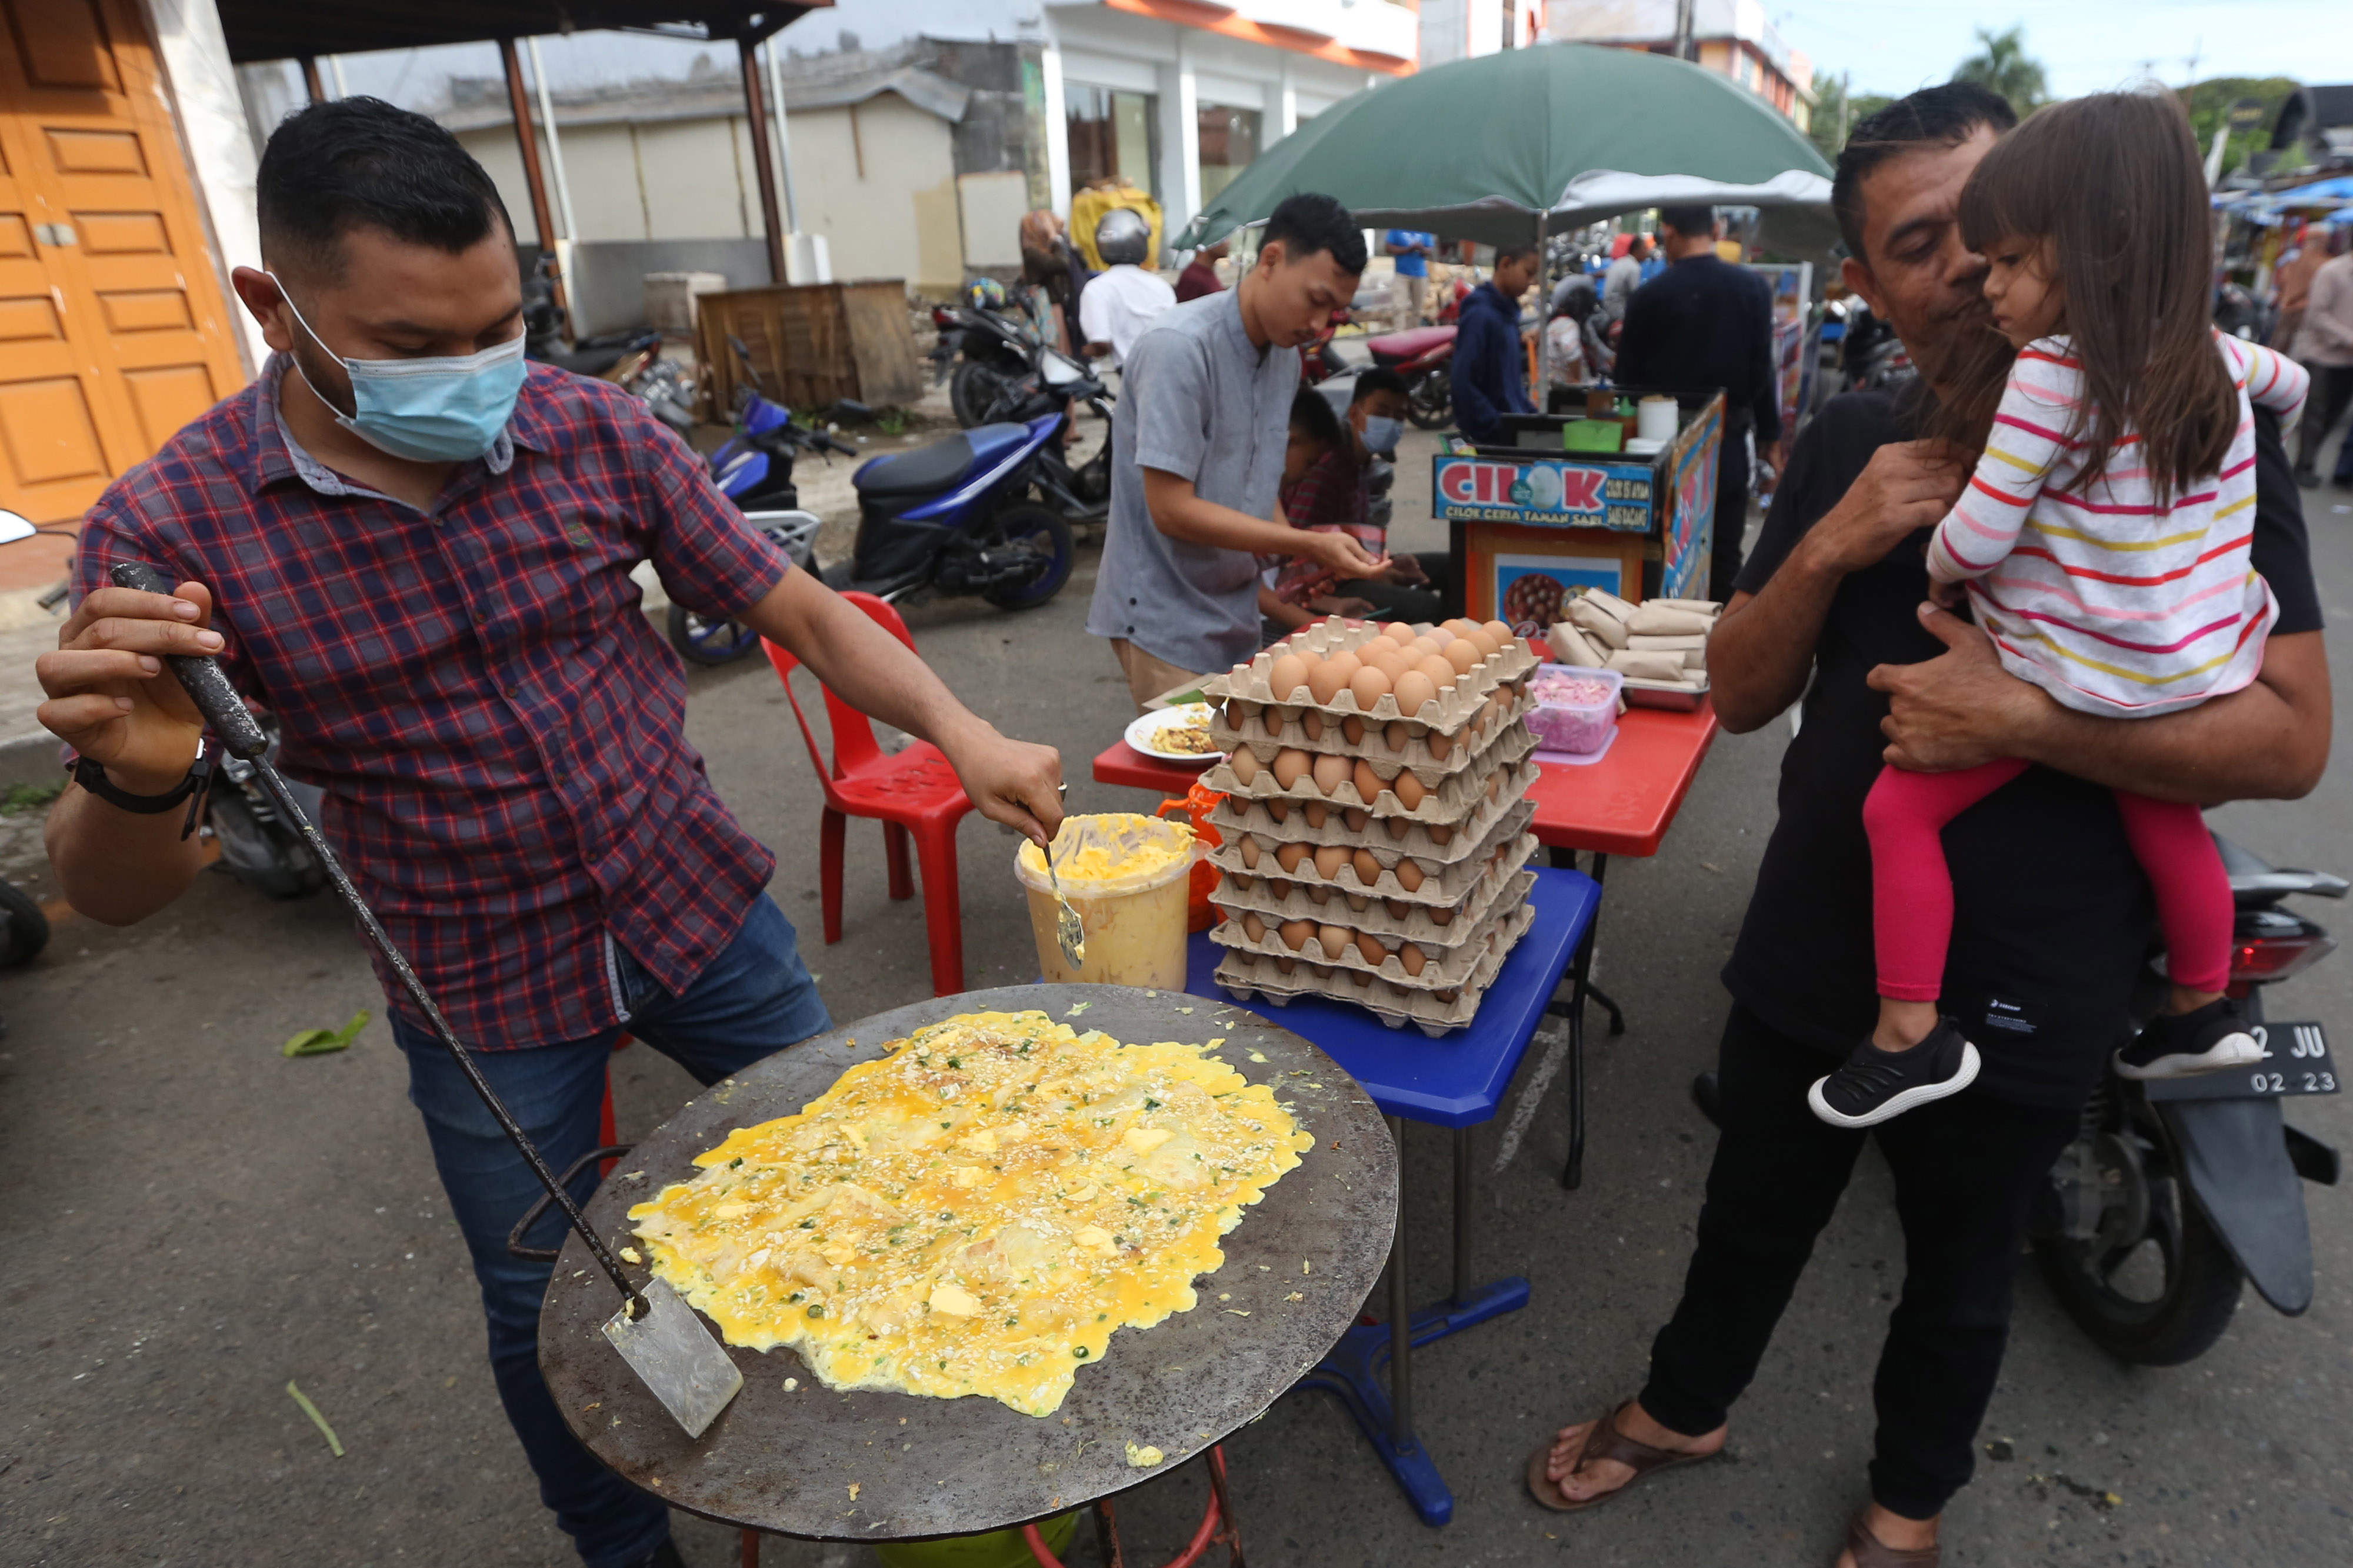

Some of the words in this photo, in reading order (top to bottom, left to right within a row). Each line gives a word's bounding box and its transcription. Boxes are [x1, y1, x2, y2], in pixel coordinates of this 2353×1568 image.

[1445, 506, 1481, 518] CILOK
[1484, 508, 1521, 521] CERIA
[1524, 510, 1569, 523] TAMAN
[2290, 1026, 2325, 1058] JU
[2251, 1072, 2286, 1093] 02
[2301, 1072, 2335, 1092] 23
